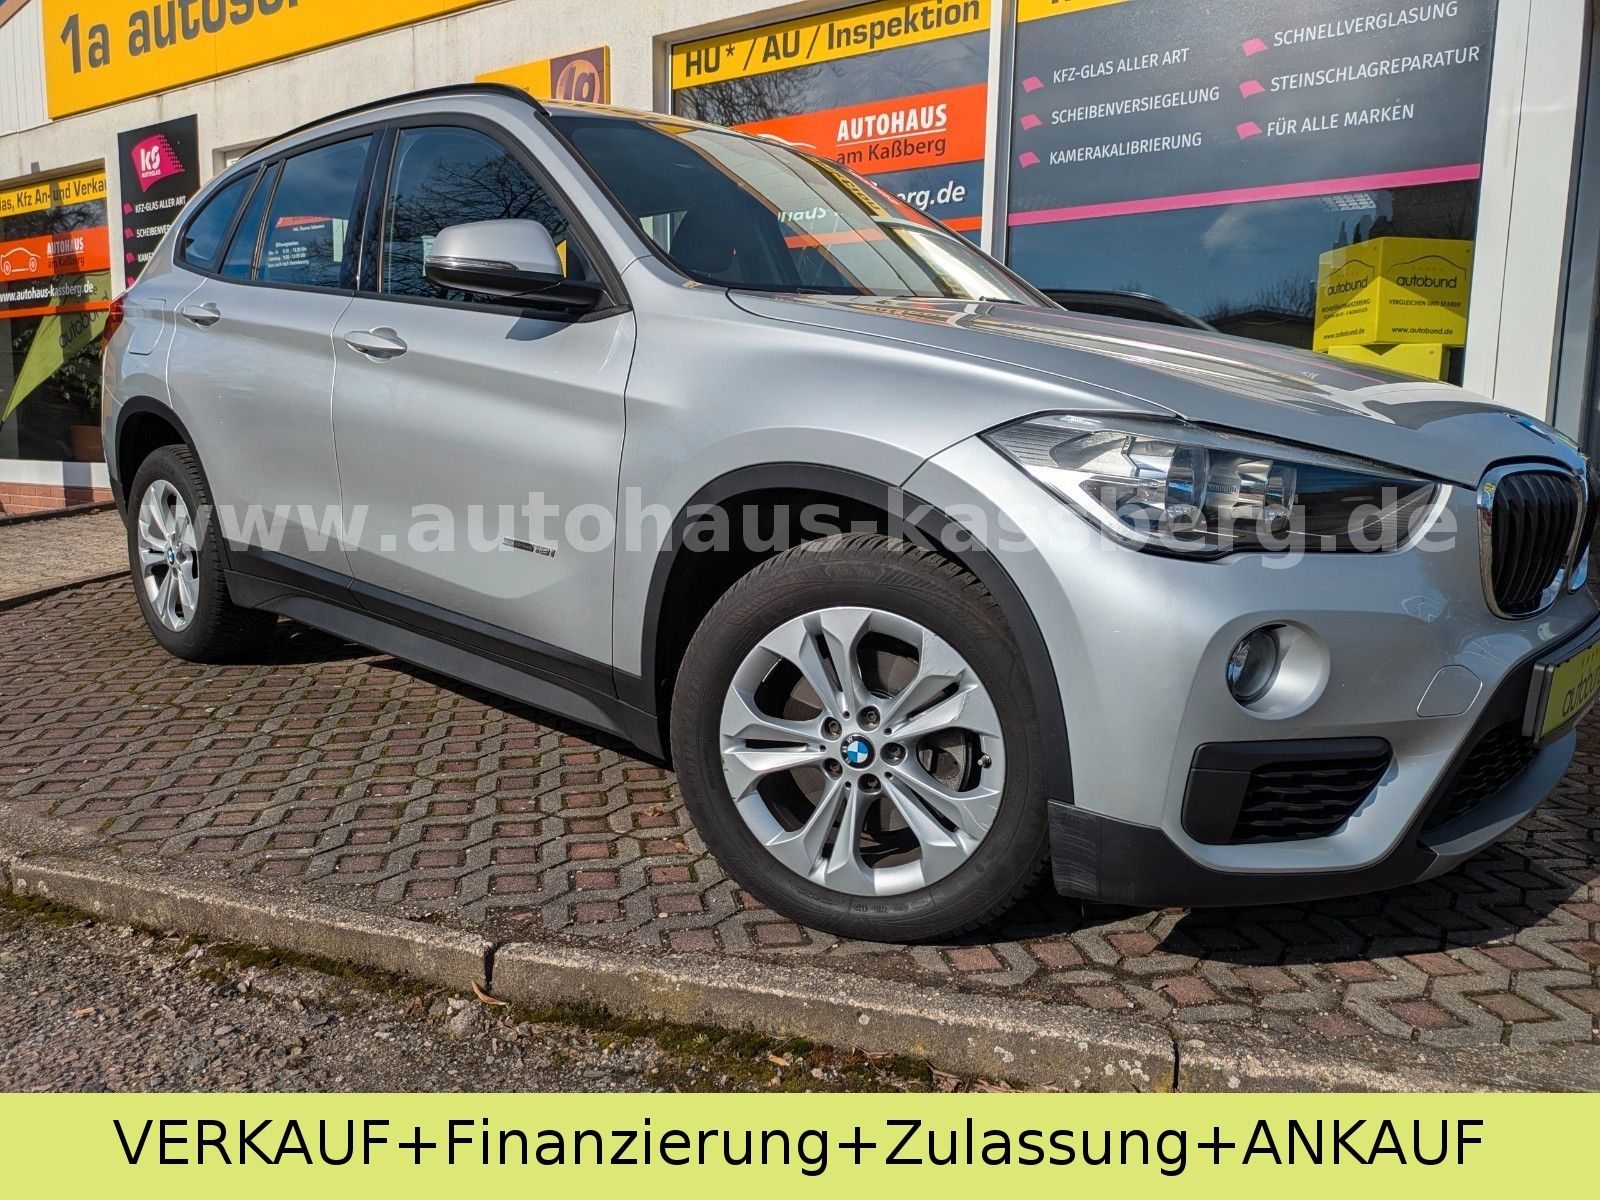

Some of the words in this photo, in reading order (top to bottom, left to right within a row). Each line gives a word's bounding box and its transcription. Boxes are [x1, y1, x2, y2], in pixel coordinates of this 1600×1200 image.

[762, 29, 801, 63] AU
[828, 0, 980, 50] Inspektion
[1273, 1, 1459, 47] SCHNELLVERGLASUNG
[60, 13, 111, 74] 1a
[1053, 60, 1115, 84] KFZ-GLAS
[1117, 53, 1159, 73] ALLER
[1162, 48, 1190, 66] ART
[1270, 45, 1481, 92] STEINSCHLAGREPARATUR
[837, 103, 948, 142] AUTOHAUS
[1051, 86, 1220, 125] SCHEIBENVERSIEGELUNG
[1267, 116, 1298, 137] FÜR
[1301, 113, 1340, 133] ALLE
[1343, 103, 1415, 127] MARKEN
[836, 149, 863, 167] am
[867, 136, 947, 162] Kaßberg
[1049, 132, 1202, 166] KAMERAKALIBRIERUNG
[17, 191, 33, 208] Kfz
[53, 186, 71, 201] und
[135, 202, 160, 214] KFZ-GLAS
[159, 199, 176, 210] ALLER
[175, 195, 187, 207] ART
[47, 237, 84, 256] AUTOHAUS
[1327, 275, 1368, 296] autobund
[1396, 274, 1457, 289] autobund
[1392, 327, 1454, 336] www.autobund.de
